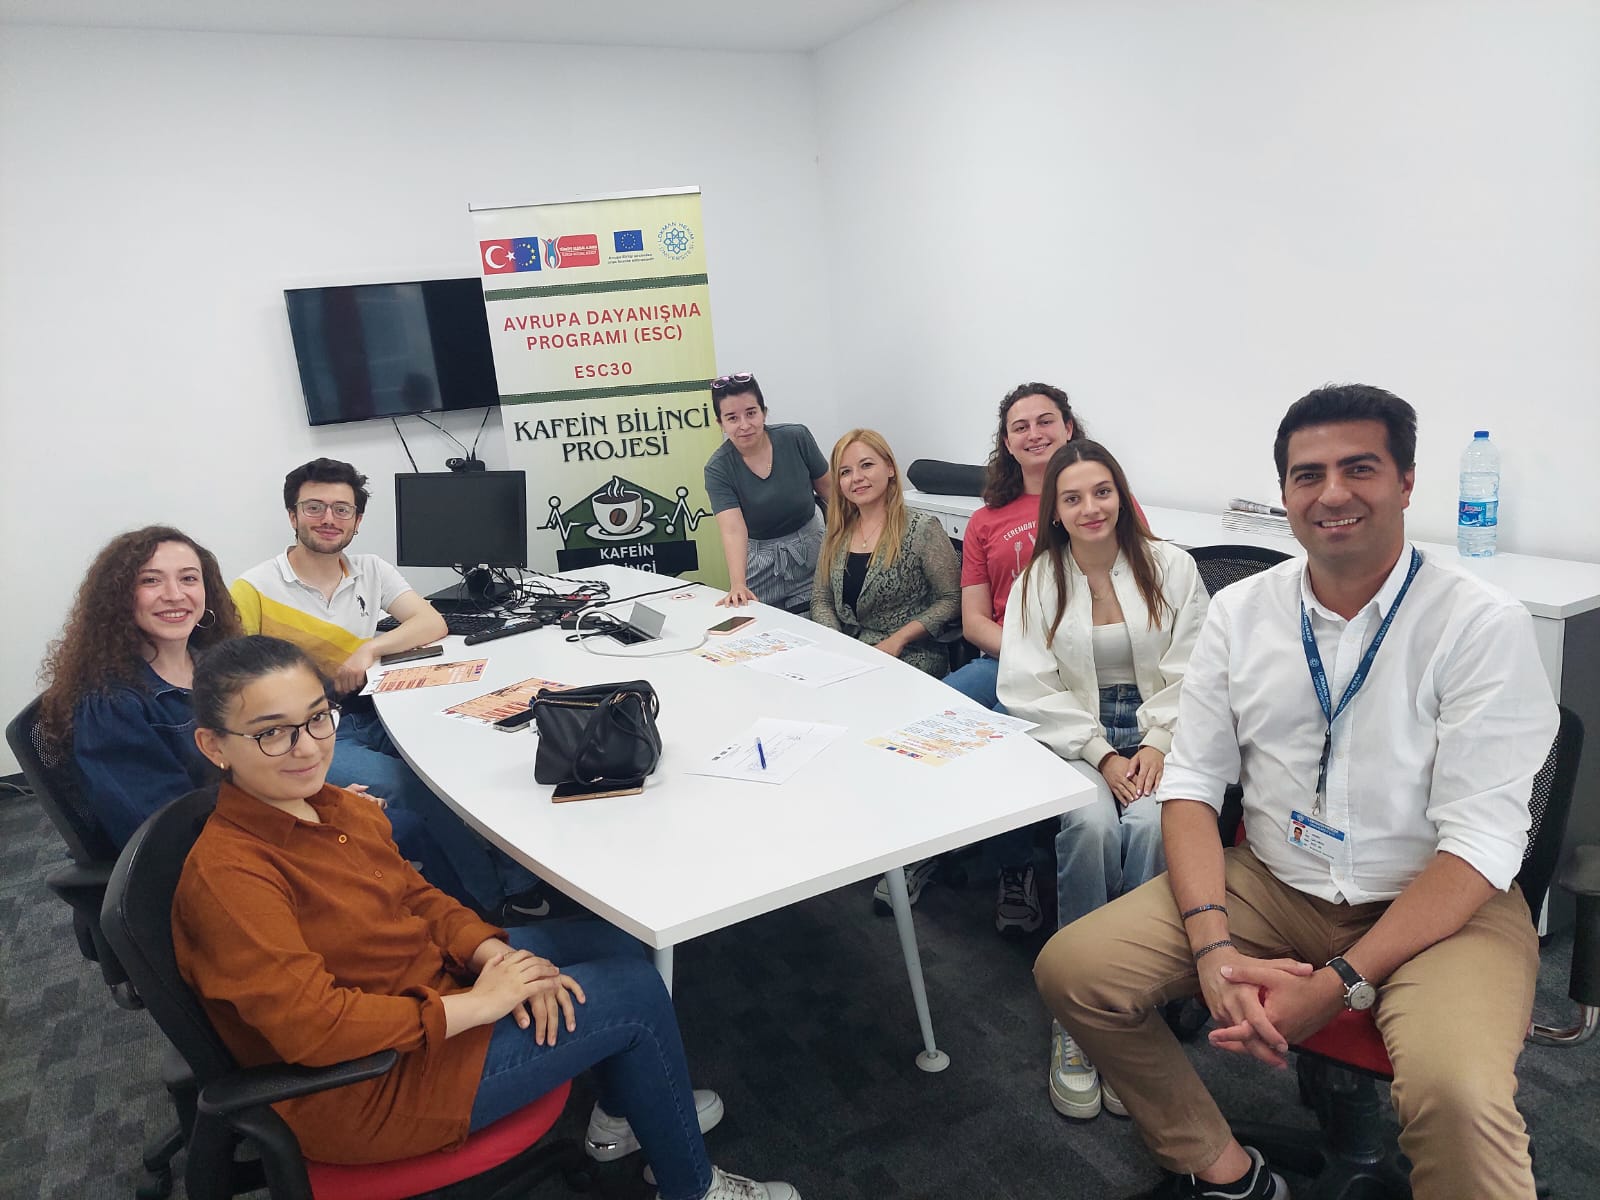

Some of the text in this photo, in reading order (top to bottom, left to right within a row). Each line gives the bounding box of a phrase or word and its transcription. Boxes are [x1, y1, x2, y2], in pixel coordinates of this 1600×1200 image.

[503, 302, 702, 332] AVRUPA DAYANIŞMA
[526, 324, 683, 350] PROGRAMI (ESC)
[574, 361, 633, 379] ESC30
[514, 402, 710, 442] KAFEİN BİLİNCİ
[562, 431, 670, 463] PROJESİ
[600, 543, 654, 560] KAFEİN
